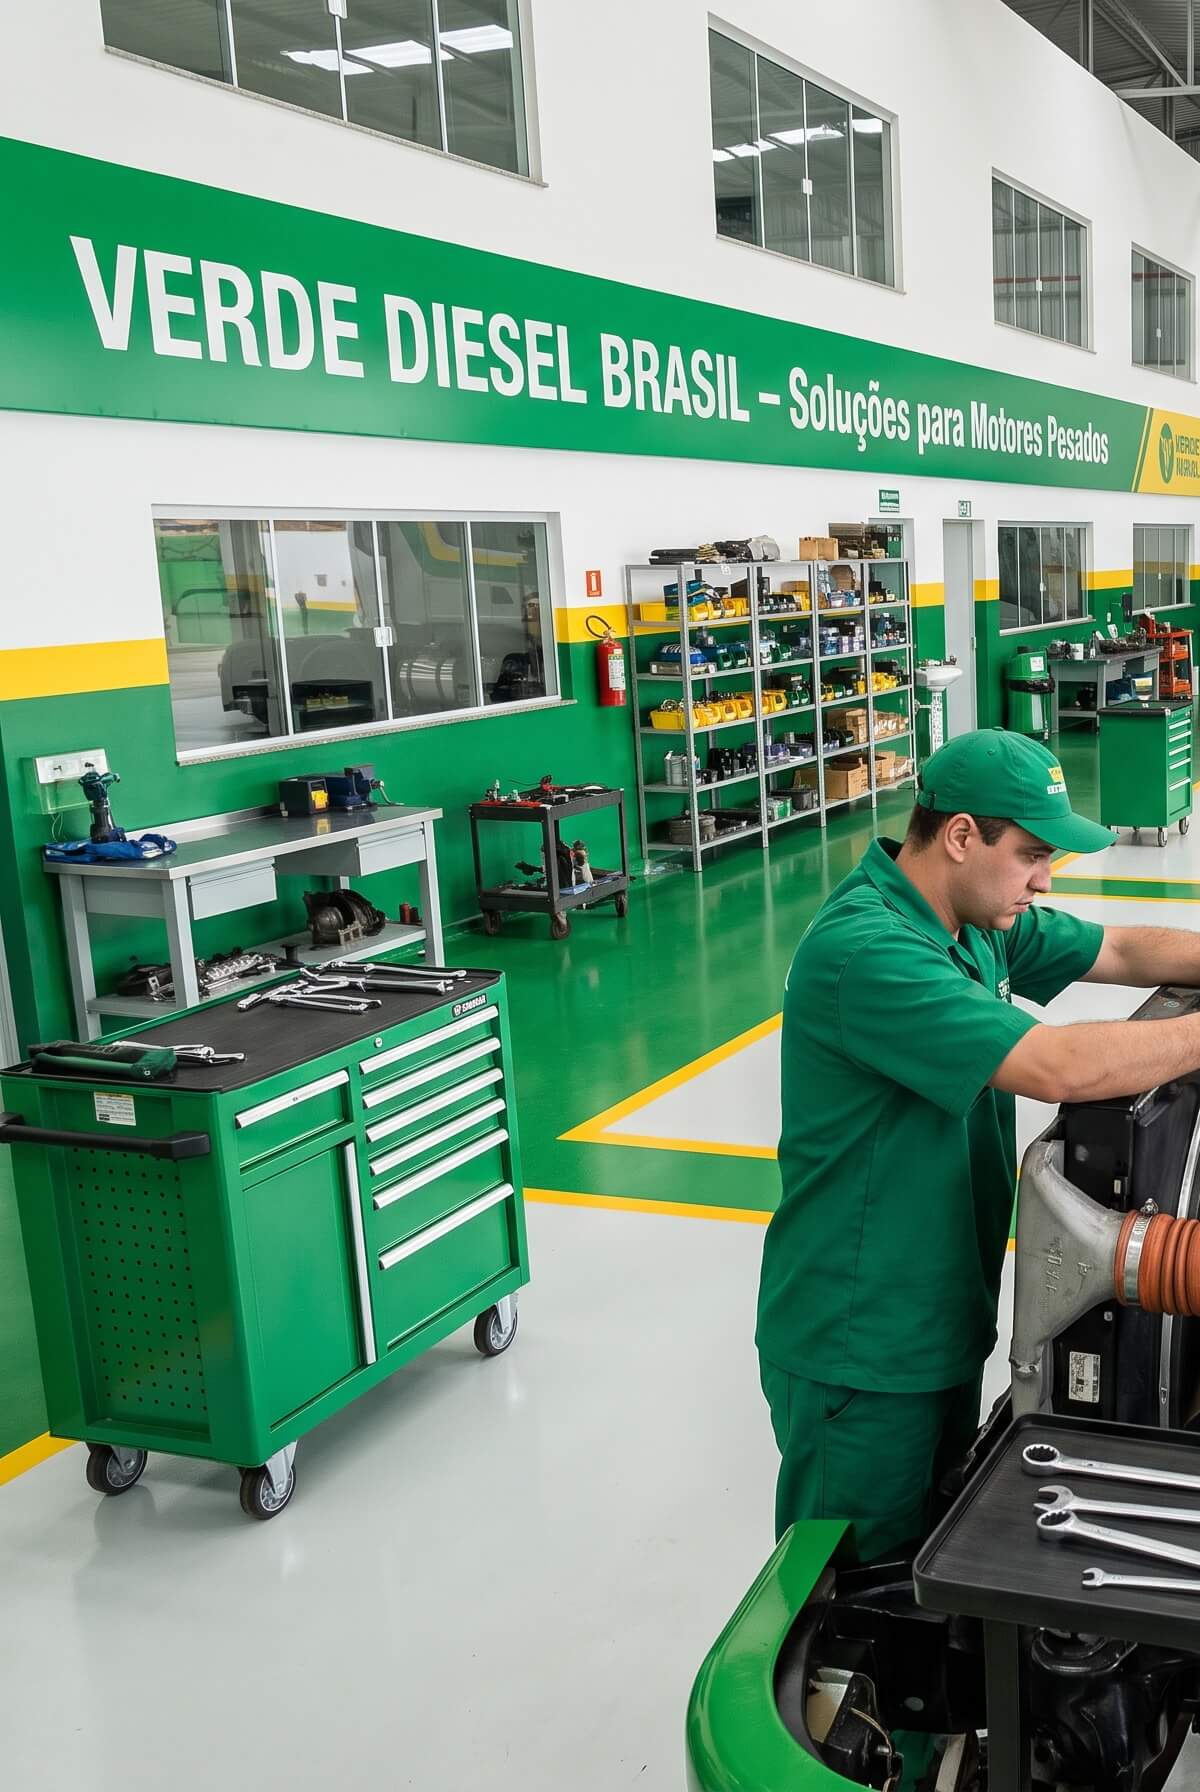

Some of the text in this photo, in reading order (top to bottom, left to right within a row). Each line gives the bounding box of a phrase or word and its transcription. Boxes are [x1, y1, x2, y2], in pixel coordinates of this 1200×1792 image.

[69, 235, 366, 379] VERDE
[383, 293, 588, 404] DIESEL
[600, 333, 751, 423] BRASIL
[788, 366, 911, 453] Soluções
[916, 403, 965, 456] para
[970, 400, 1043, 457] Motores
[1047, 415, 1112, 465] Pesados
